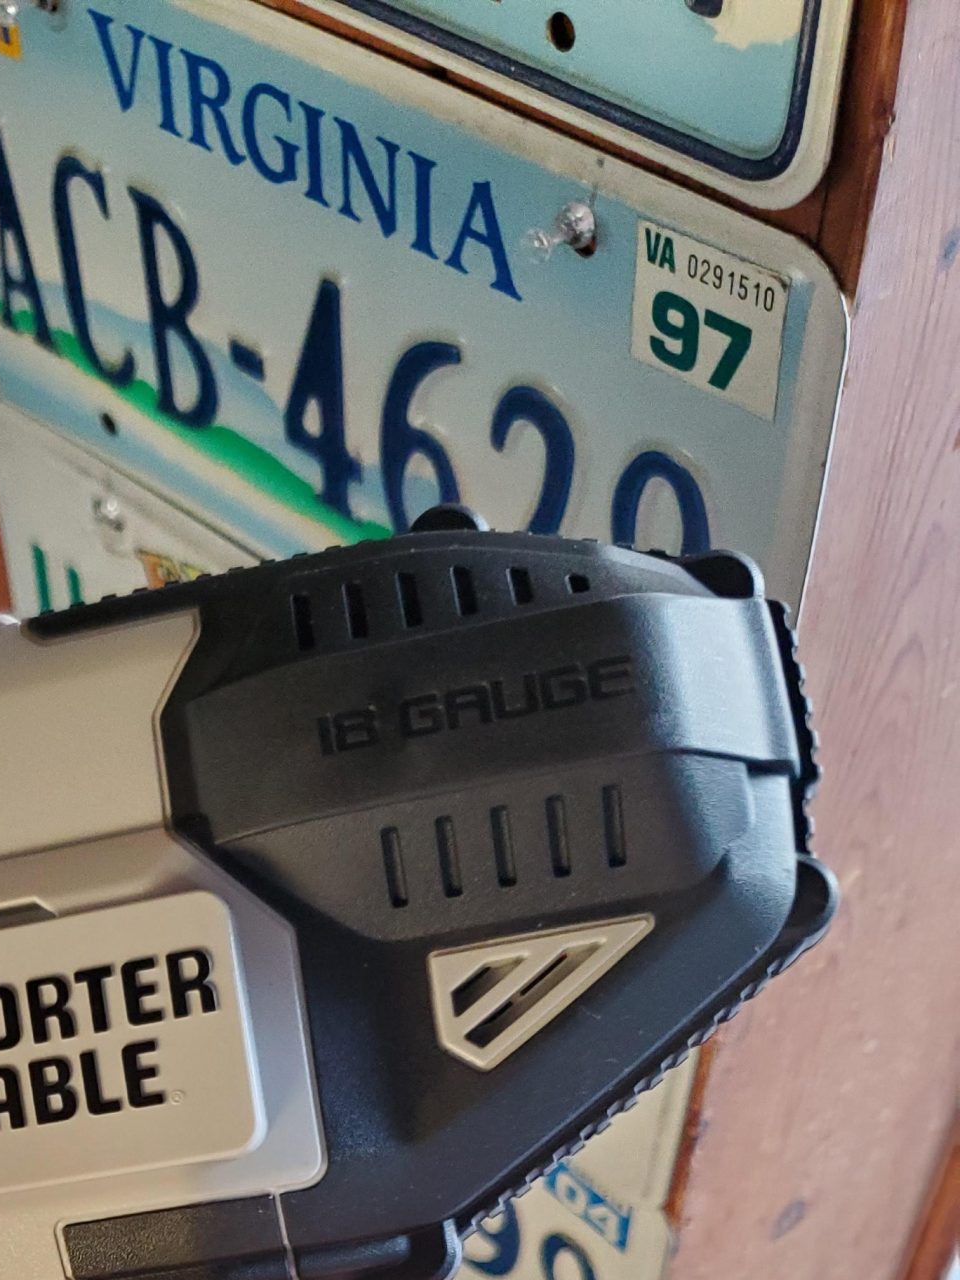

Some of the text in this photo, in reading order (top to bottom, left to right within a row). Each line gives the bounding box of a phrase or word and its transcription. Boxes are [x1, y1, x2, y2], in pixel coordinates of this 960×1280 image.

[88, 8, 524, 302] VIRGINIA
[645, 227, 775, 312] VA 0291510
[650, 291, 753, 391] 97
[318, 654, 636, 756] 18 GAUGE
